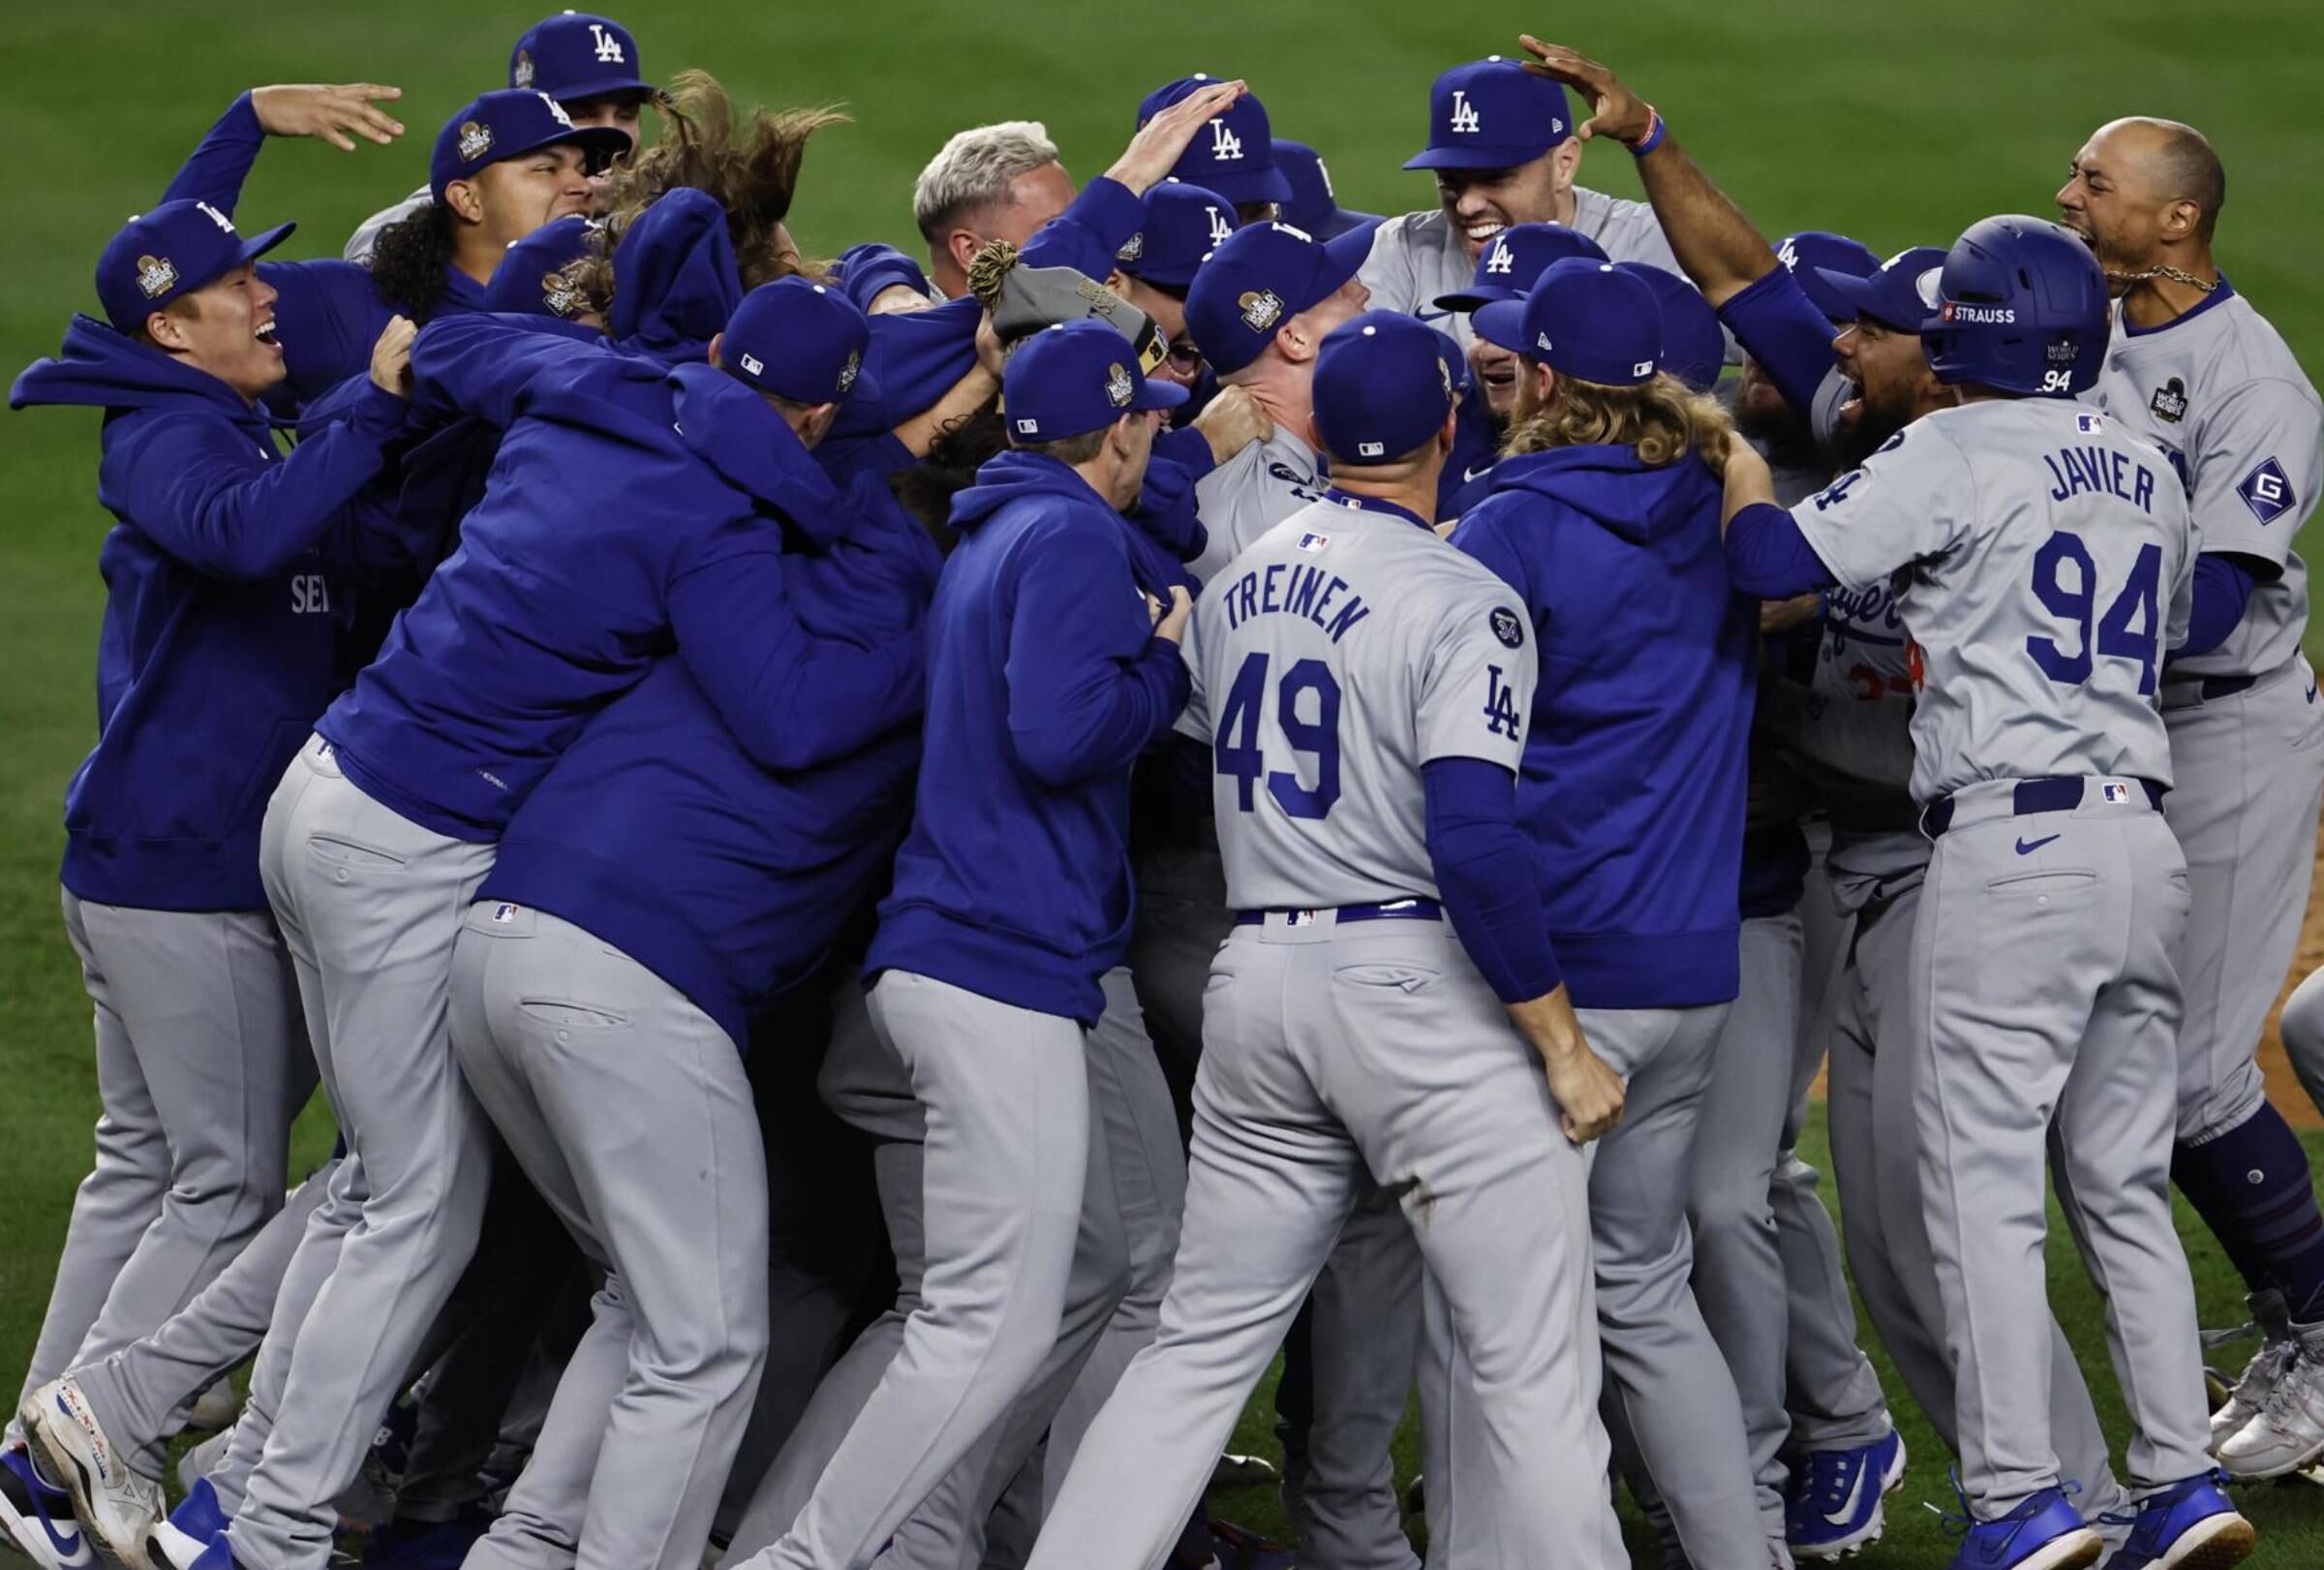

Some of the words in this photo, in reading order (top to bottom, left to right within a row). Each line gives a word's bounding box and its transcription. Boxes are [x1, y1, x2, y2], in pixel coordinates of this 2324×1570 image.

[588, 24, 625, 63] LA
[1451, 90, 1481, 133] LA
[1208, 118, 1244, 161] LA
[1205, 205, 1234, 247] LA
[1486, 234, 1514, 273] LA
[1954, 306, 2015, 323] STRAUSS
[2042, 370, 2072, 392] 94
[2156, 391, 2185, 410] WORLD
[2043, 446, 2155, 514] JAVIER
[2256, 473, 2282, 500] G
[1224, 564, 1370, 645] TREINEN
[2026, 530, 2162, 696] 94
[1483, 663, 1520, 742] LA
[1214, 652, 1341, 820] 49
